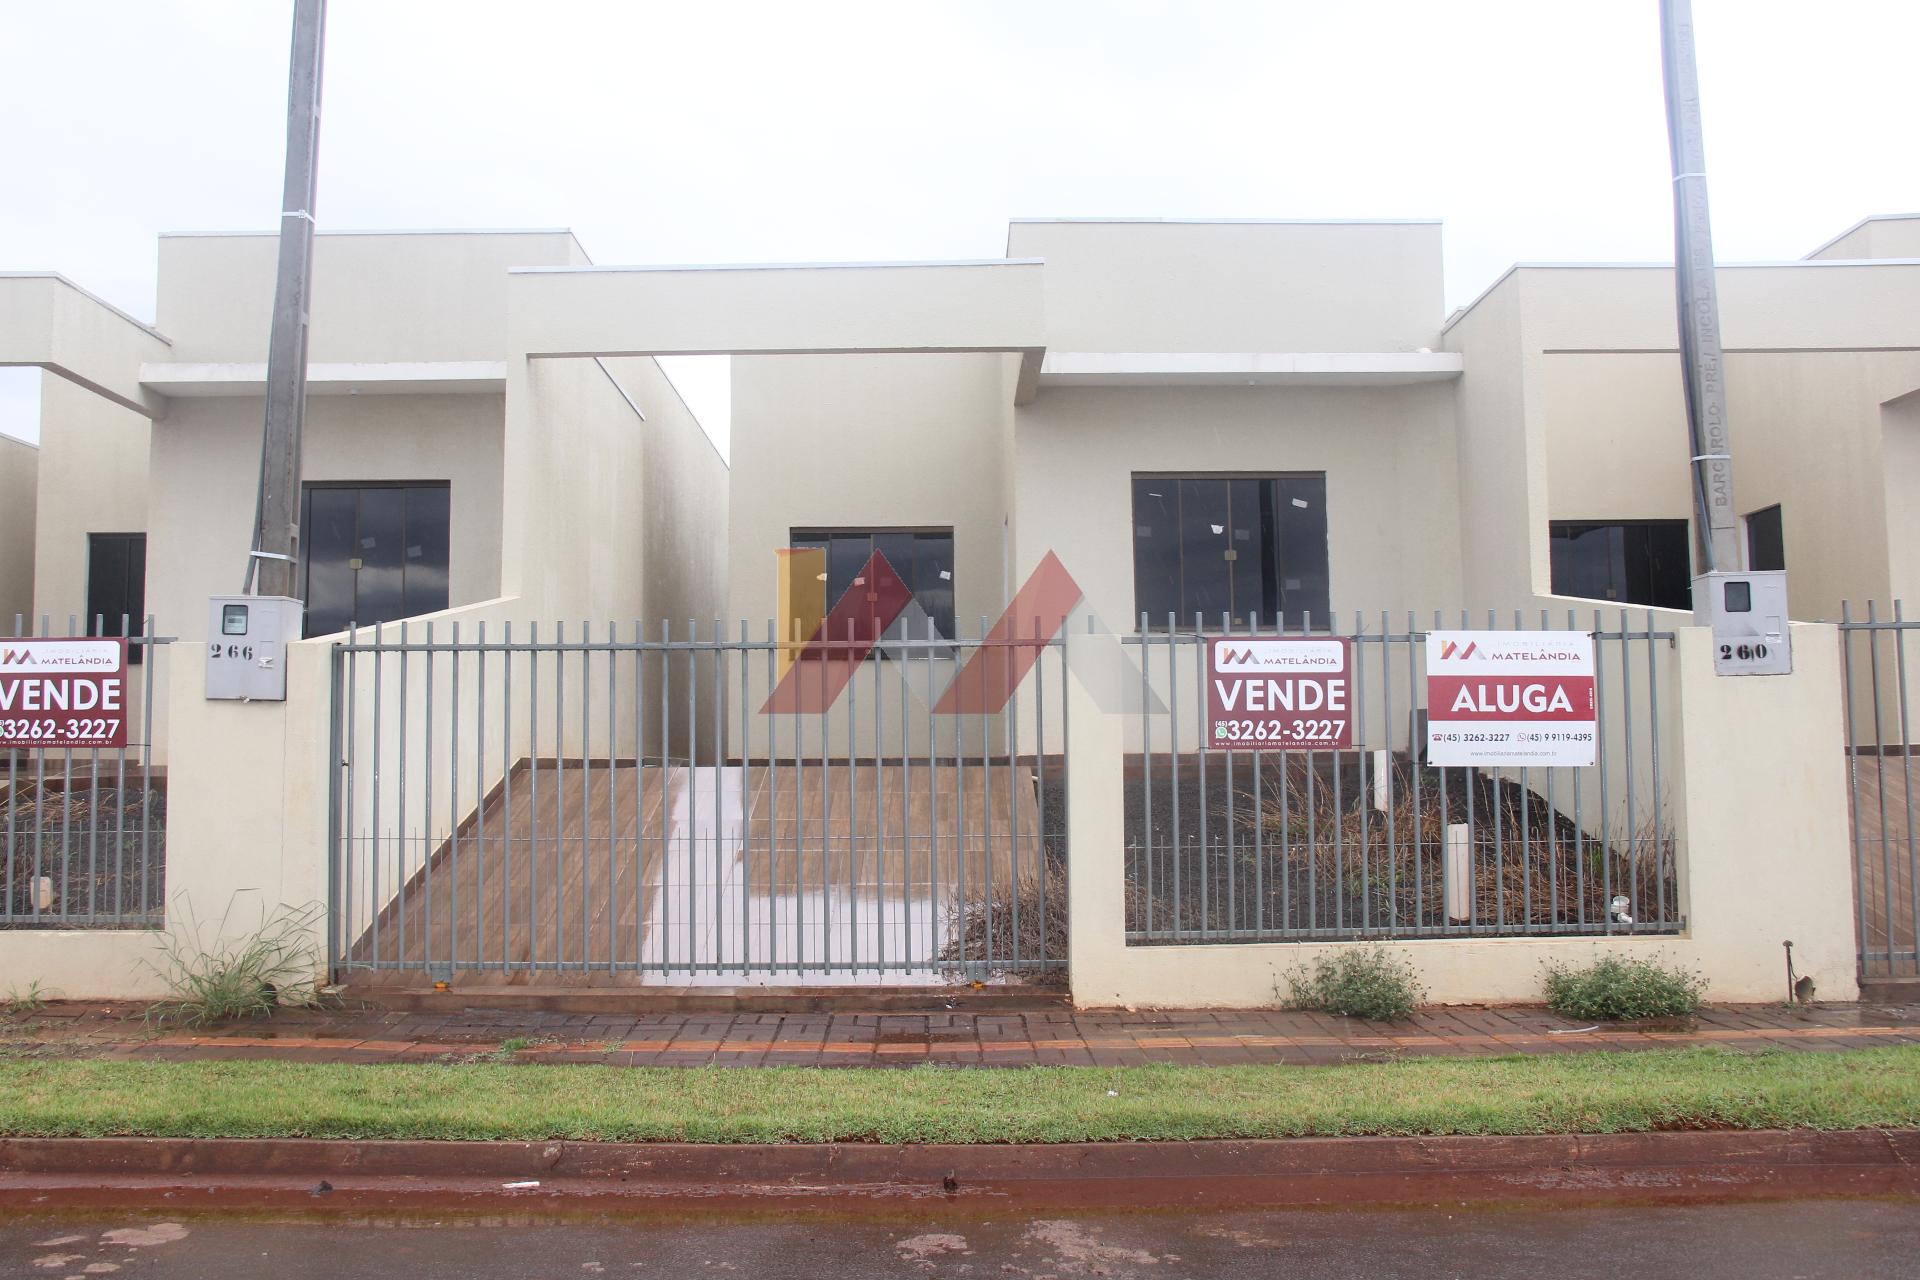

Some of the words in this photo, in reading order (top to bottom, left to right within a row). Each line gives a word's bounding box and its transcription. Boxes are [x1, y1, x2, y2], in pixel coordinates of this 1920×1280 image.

[41, 654, 113, 665] MATELÂNDIA
[211, 643, 254, 661] 266
[1263, 654, 1337, 665] MATELÂNDIA
[1491, 648, 1581, 661] MATELÂNDIA
[1719, 643, 1768, 660] 260
[0, 679, 121, 710] VENDE
[1214, 679, 1346, 712] VENDE
[1450, 683, 1574, 713] ALUGA
[4, 719, 120, 739] 3262-3227
[1227, 719, 1346, 740] 3262-3227
[1443, 733, 1461, 743] (45)
[1463, 733, 1510, 742] 3262-3227
[1526, 733, 1543, 743] (45)
[1551, 733, 1593, 742] 9119-4395
